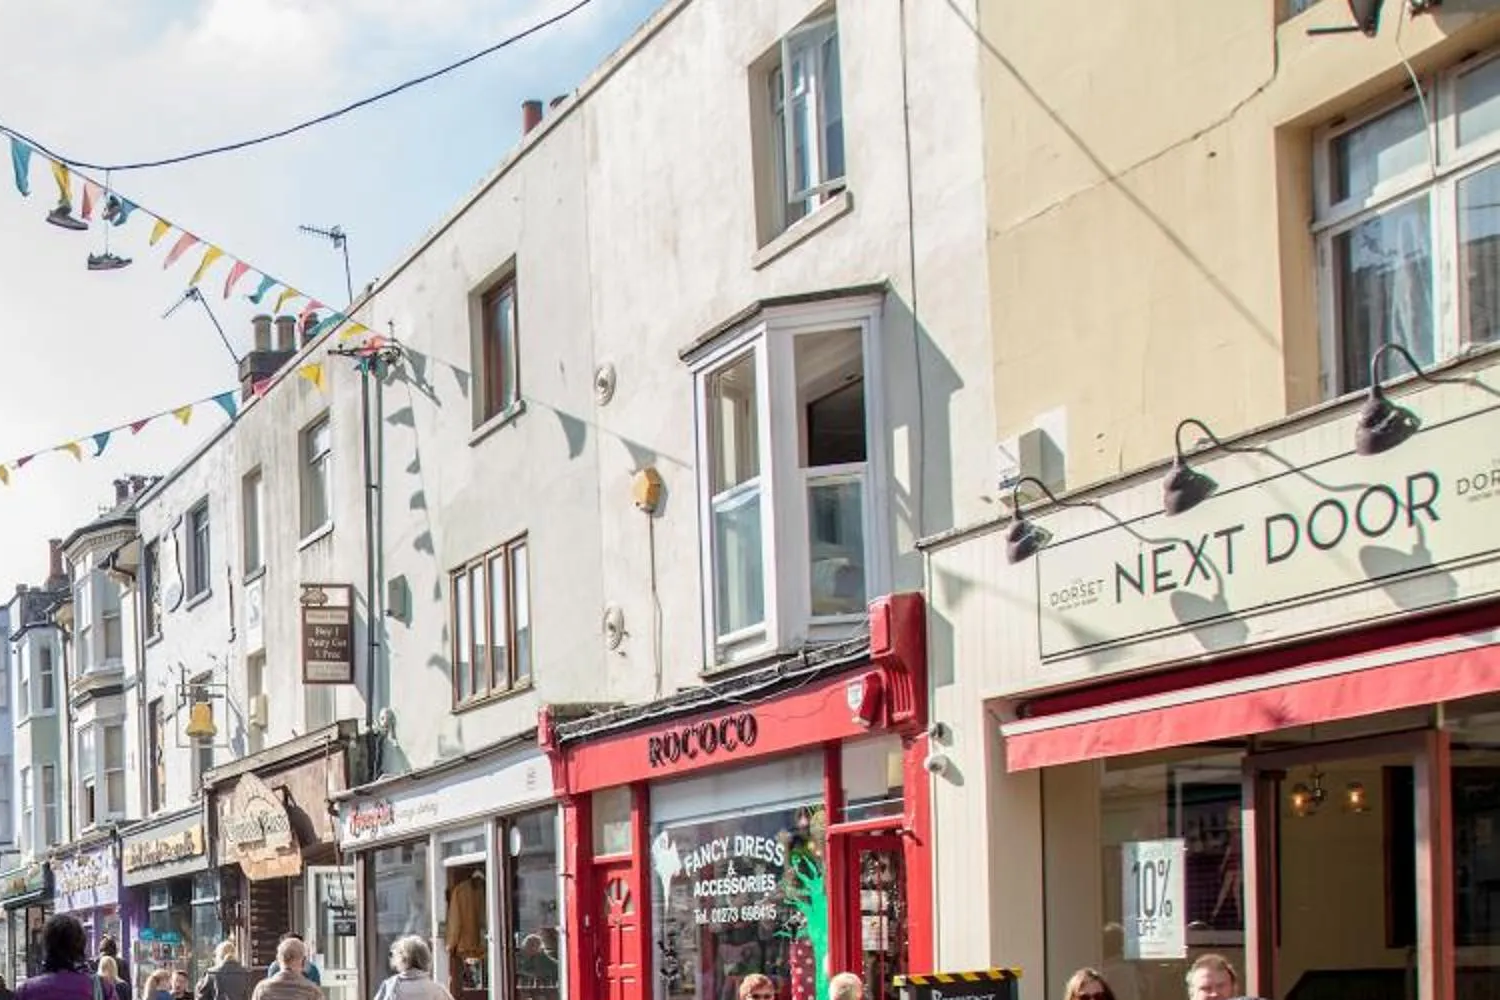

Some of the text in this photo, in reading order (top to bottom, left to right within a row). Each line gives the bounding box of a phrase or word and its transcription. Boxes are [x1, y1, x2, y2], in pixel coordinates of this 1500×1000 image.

[1115, 471, 1440, 603] NEXT DOOR
[1050, 579, 1104, 607] DORSET
[648, 712, 758, 768] ROCOCO
[683, 835, 785, 877] FANCY DRESS
[693, 874, 776, 898] ACCESSORIES
[1132, 859, 1173, 918] 10%
[711, 907, 738, 922] 01273
